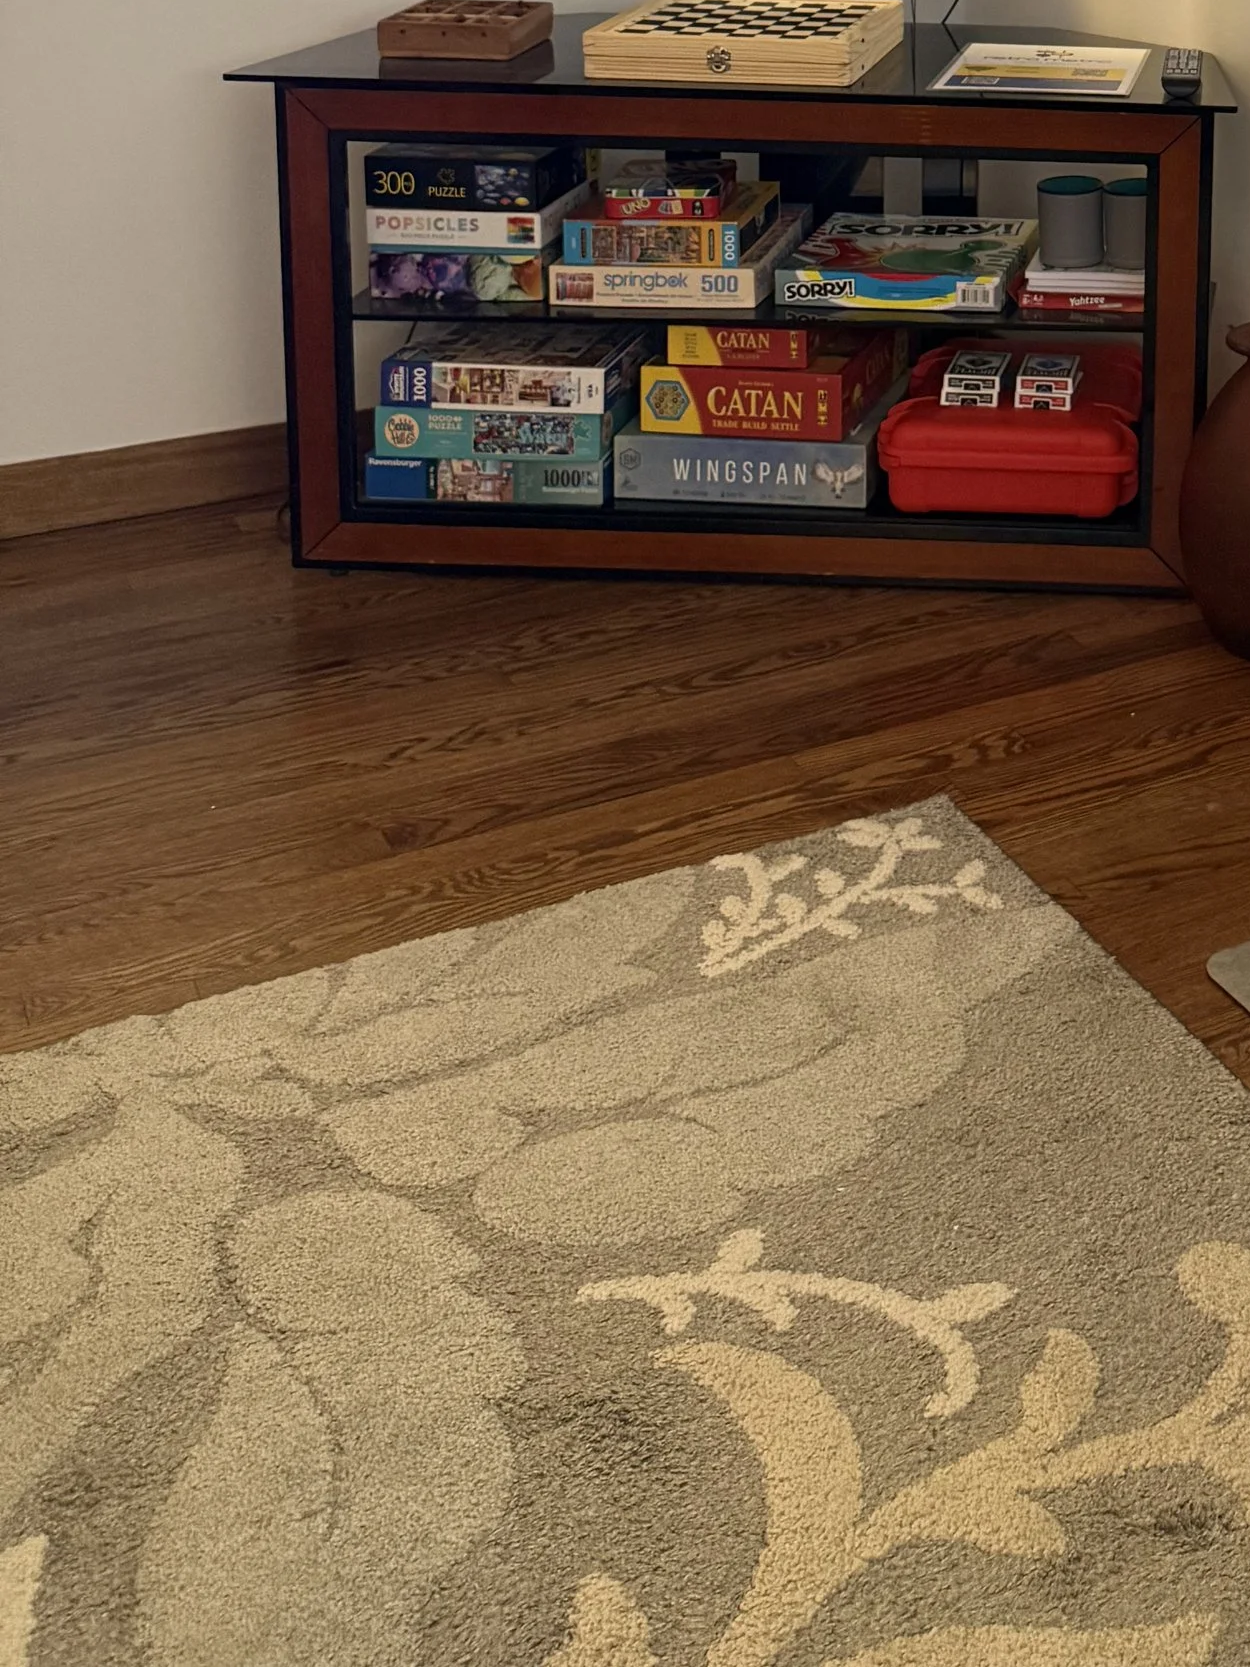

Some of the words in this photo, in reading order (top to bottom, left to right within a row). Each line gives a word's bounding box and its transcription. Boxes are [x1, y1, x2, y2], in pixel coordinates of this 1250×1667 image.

[372, 170, 415, 196] 300
[428, 186, 466, 198] PUZZLE
[621, 197, 651, 216] UNO
[375, 215, 480, 233] POPSICLES
[834, 222, 1016, 237] SORRY!
[724, 230, 735, 262] 1000
[603, 271, 688, 292] springbok
[701, 274, 739, 294] 500
[784, 278, 856, 301] SORRY!
[1069, 296, 1106, 307] Yahtzee
[717, 330, 770, 350] CATAN
[413, 367, 427, 402] 1000
[706, 386, 804, 420] CATAN
[368, 456, 422, 467] Ravensburger
[673, 458, 807, 486] WINGSPAN
[543, 469, 581, 487] 1000
